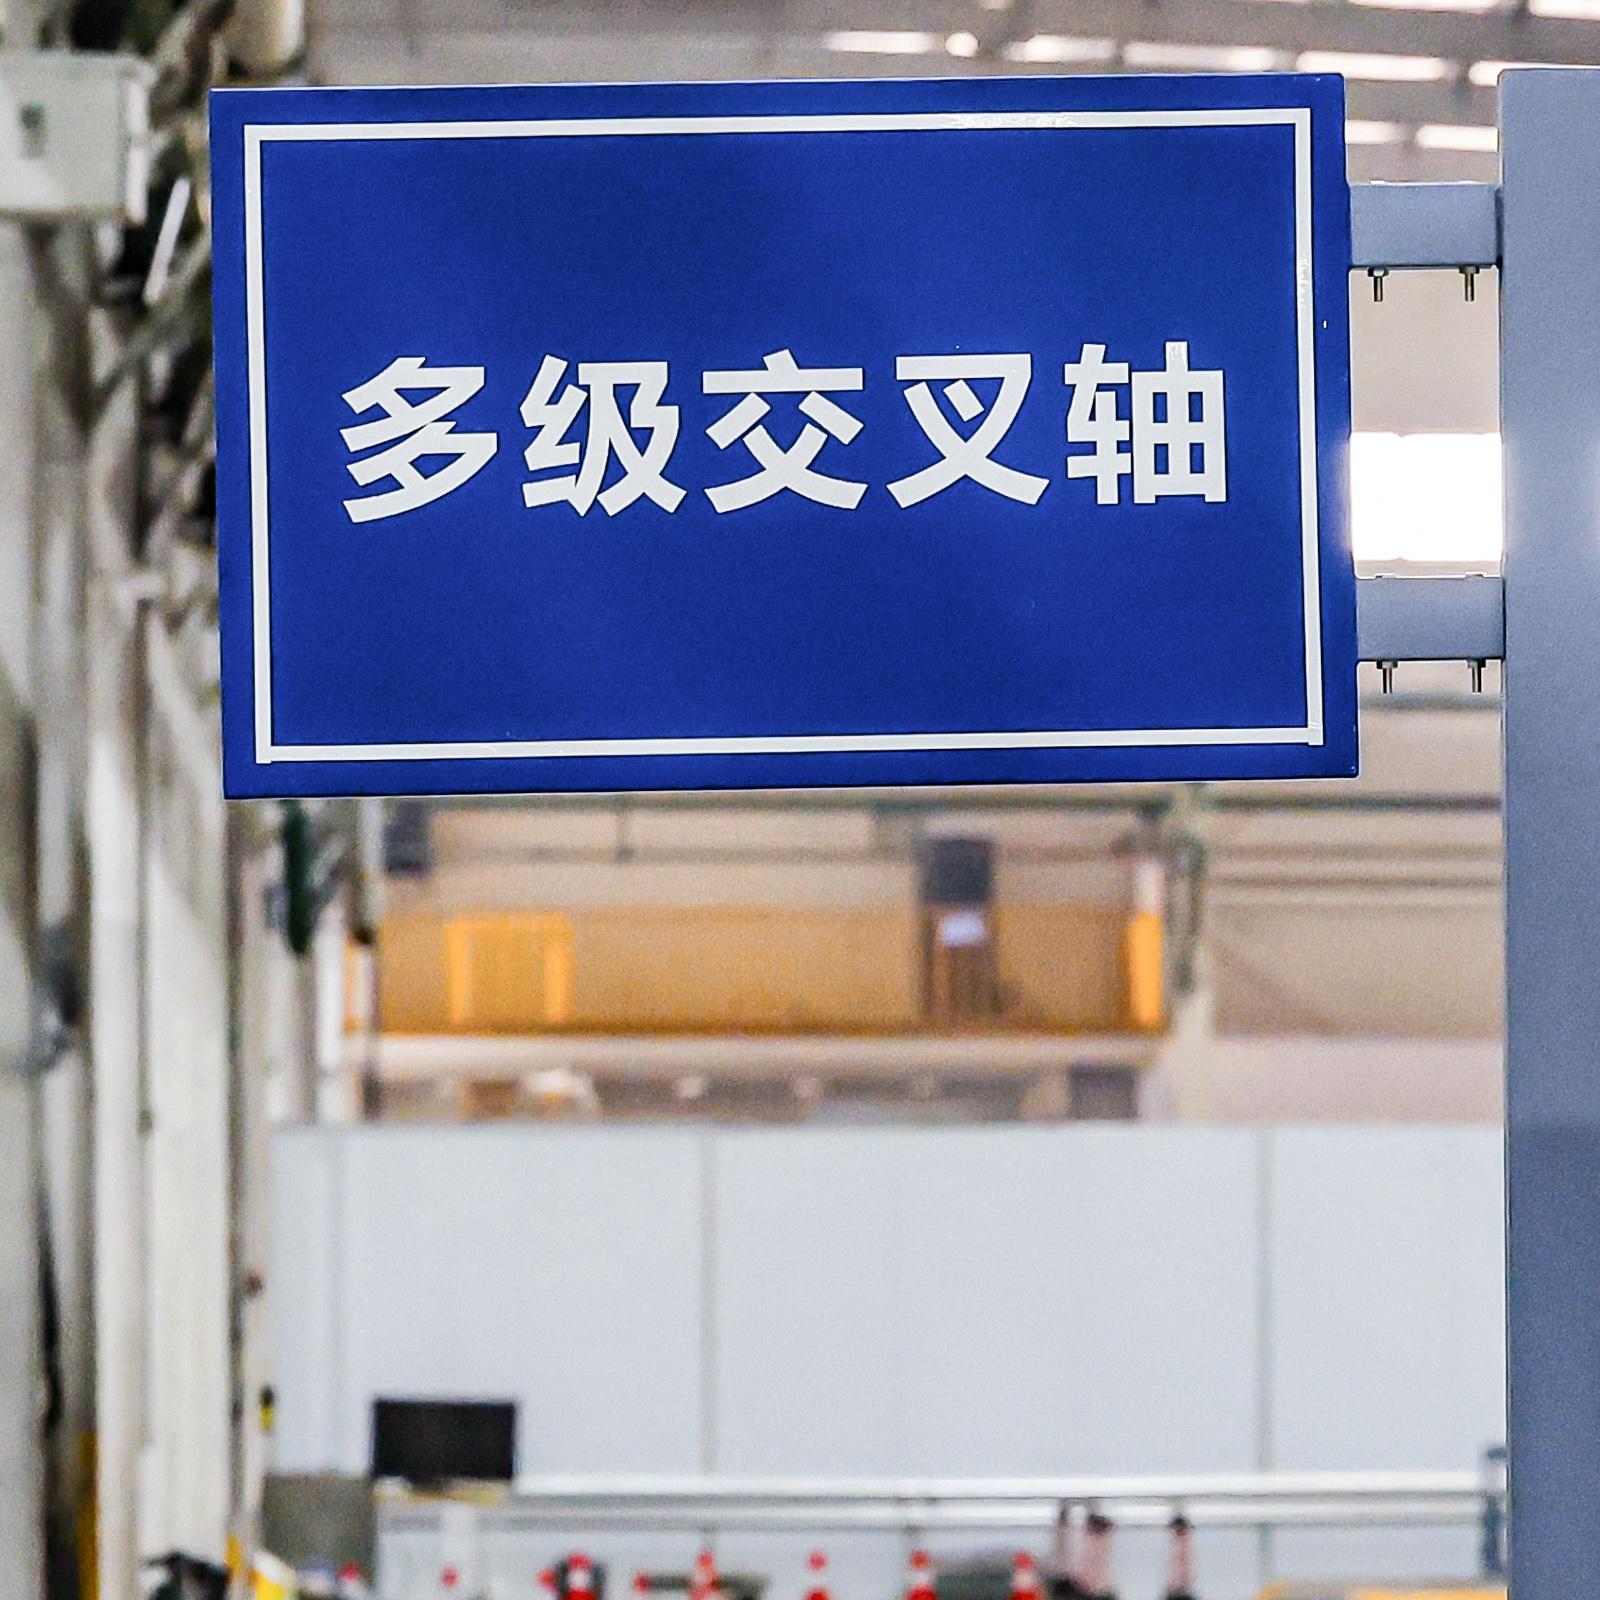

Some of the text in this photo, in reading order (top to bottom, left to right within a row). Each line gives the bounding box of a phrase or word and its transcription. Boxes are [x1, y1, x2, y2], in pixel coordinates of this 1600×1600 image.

[341, 342, 1226, 522] 多级交叉轴
